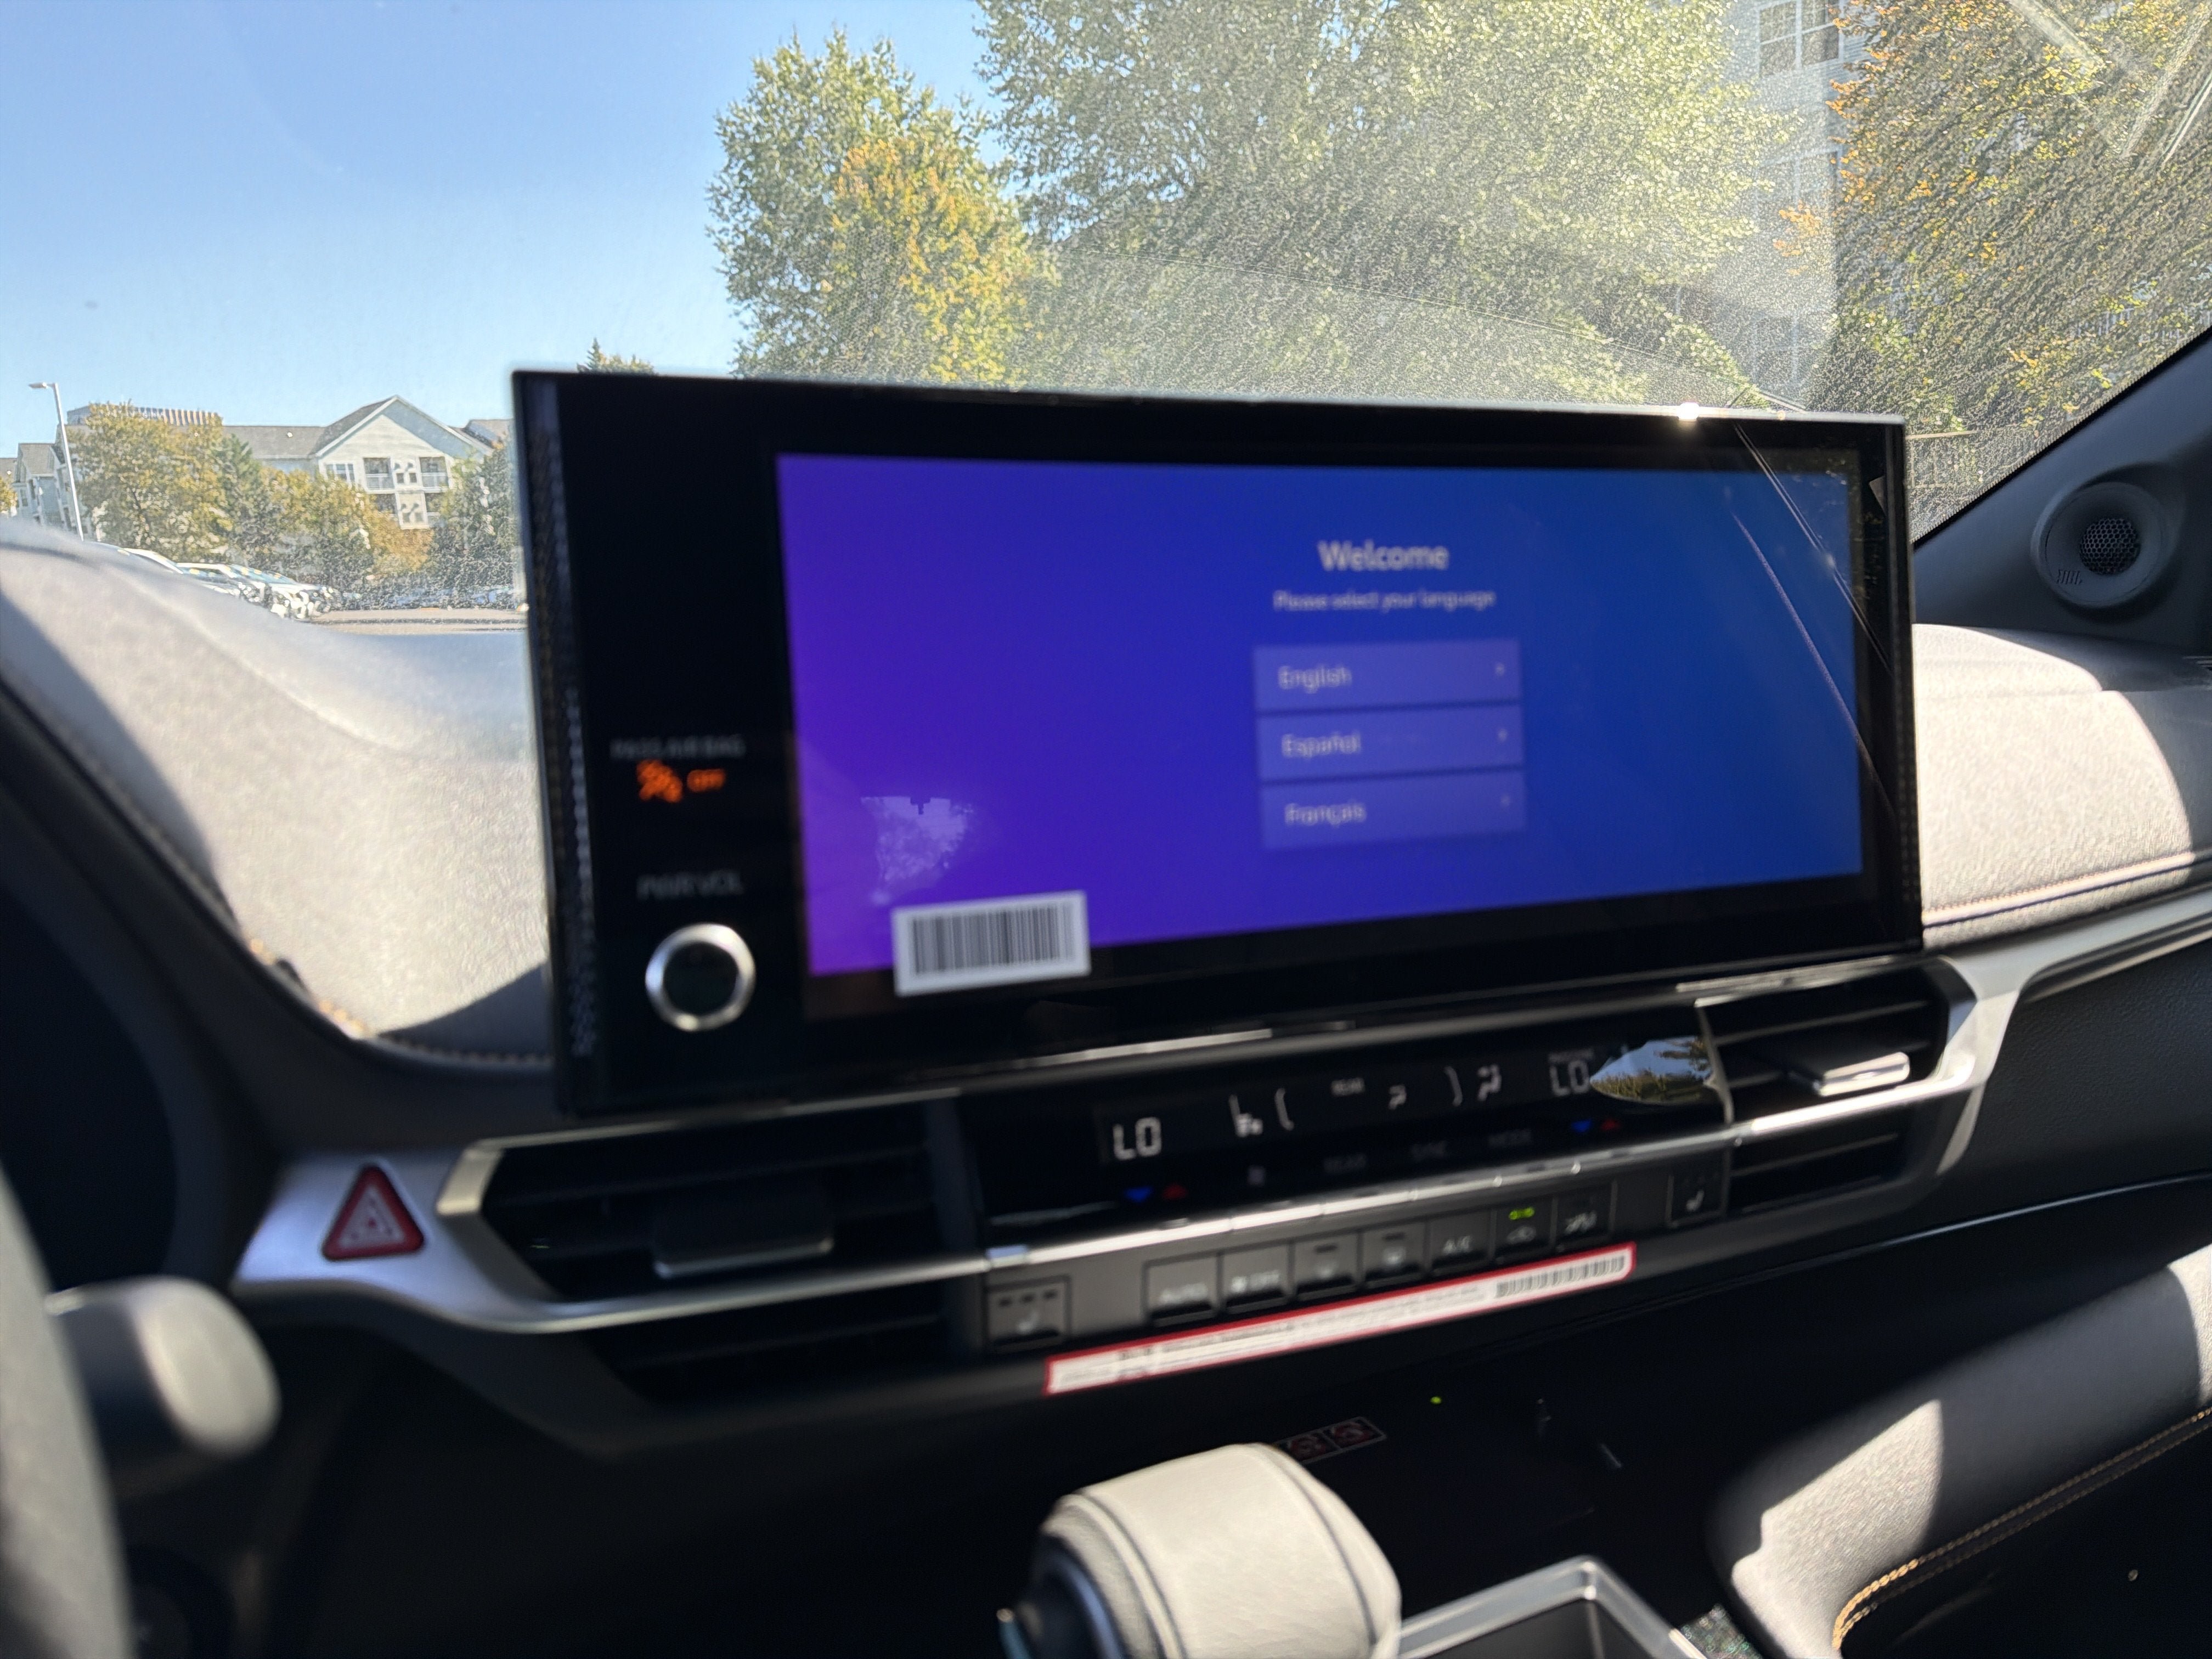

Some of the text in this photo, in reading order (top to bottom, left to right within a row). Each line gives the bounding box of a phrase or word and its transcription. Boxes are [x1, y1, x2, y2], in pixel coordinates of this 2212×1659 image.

[1318, 540, 1449, 571] Welcome
[1273, 588, 1497, 613] Please select your language
[1278, 665, 1352, 693] English
[1282, 730, 1362, 758] Español
[1285, 799, 1367, 827] Français
[1113, 1116, 1162, 1161] LO
